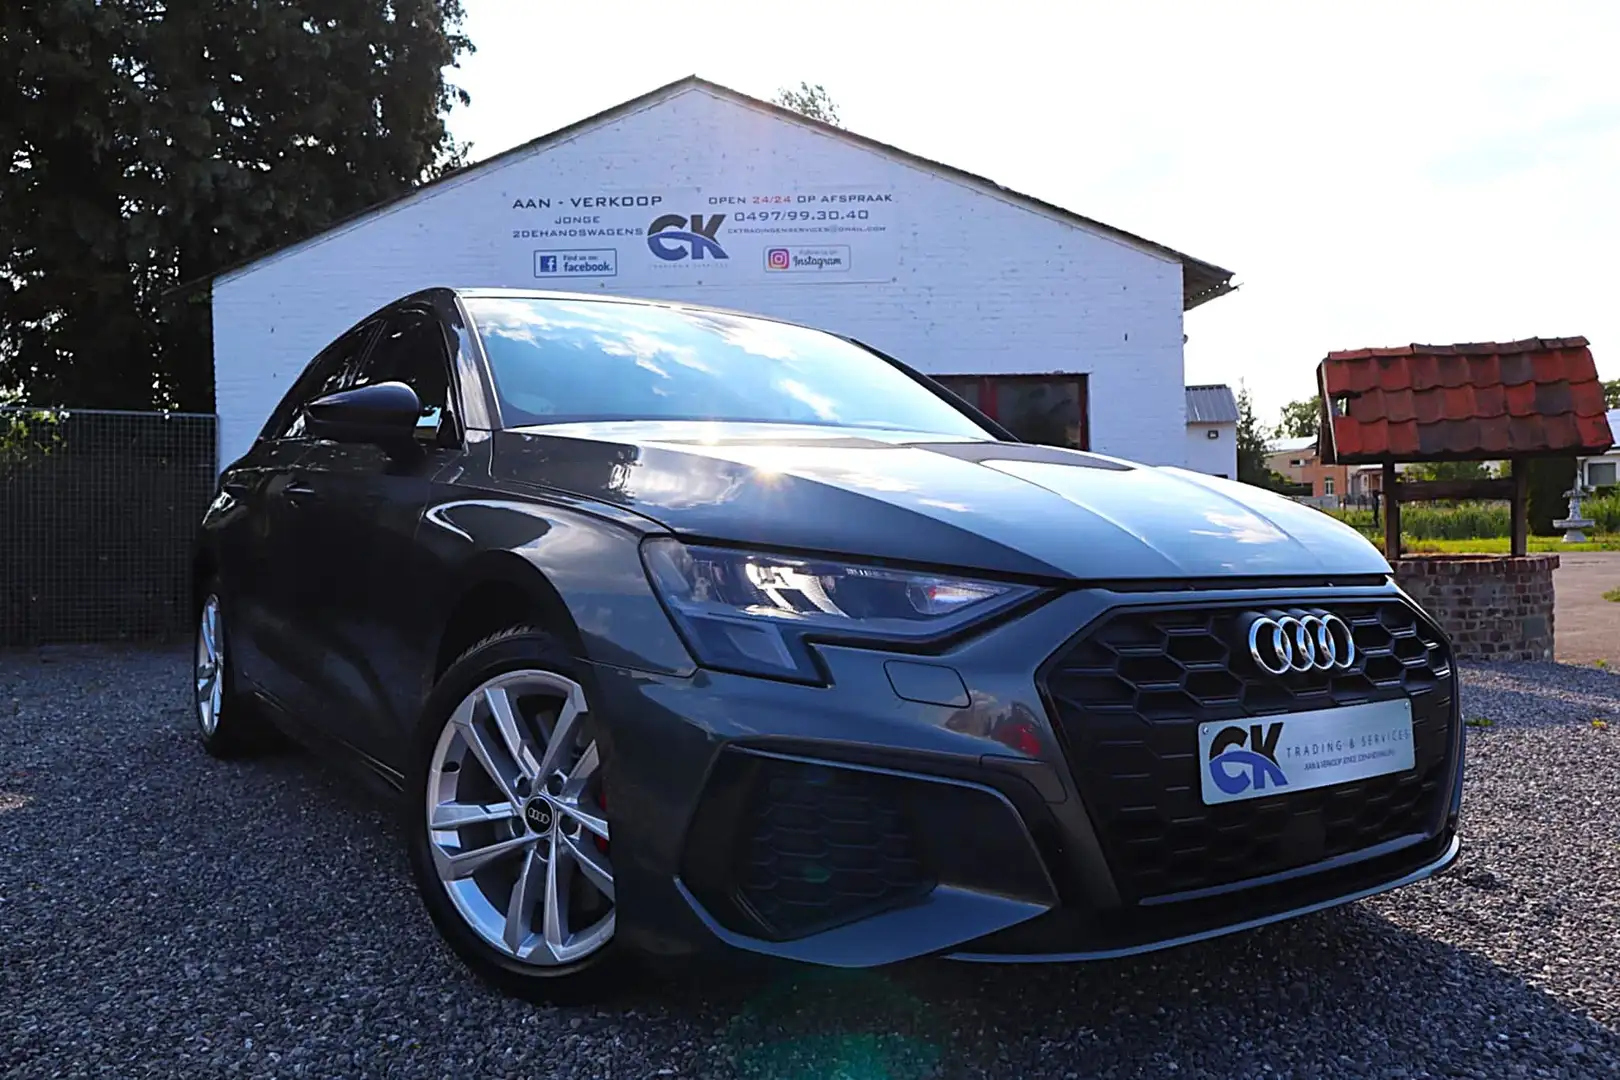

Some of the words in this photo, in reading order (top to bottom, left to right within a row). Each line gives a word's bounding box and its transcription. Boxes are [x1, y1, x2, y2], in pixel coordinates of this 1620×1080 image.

[512, 198, 551, 209] AAN
[571, 196, 663, 208] VERKOOP
[708, 196, 746, 205] OPEN
[752, 195, 792, 204] 24/24
[797, 195, 816, 204] OP
[821, 194, 893, 203] AFSPRAAK
[554, 215, 601, 225] JONGE
[734, 209, 870, 222] 0497/99.30.40
[512, 227, 644, 238] 2DEHANDSWAGENS
[647, 214, 730, 261] CK
[792, 255, 843, 269] Instagram
[1286, 739, 1343, 759] TRADING
[1361, 728, 1412, 748] SERVICES
[1209, 721, 1289, 794] CK
